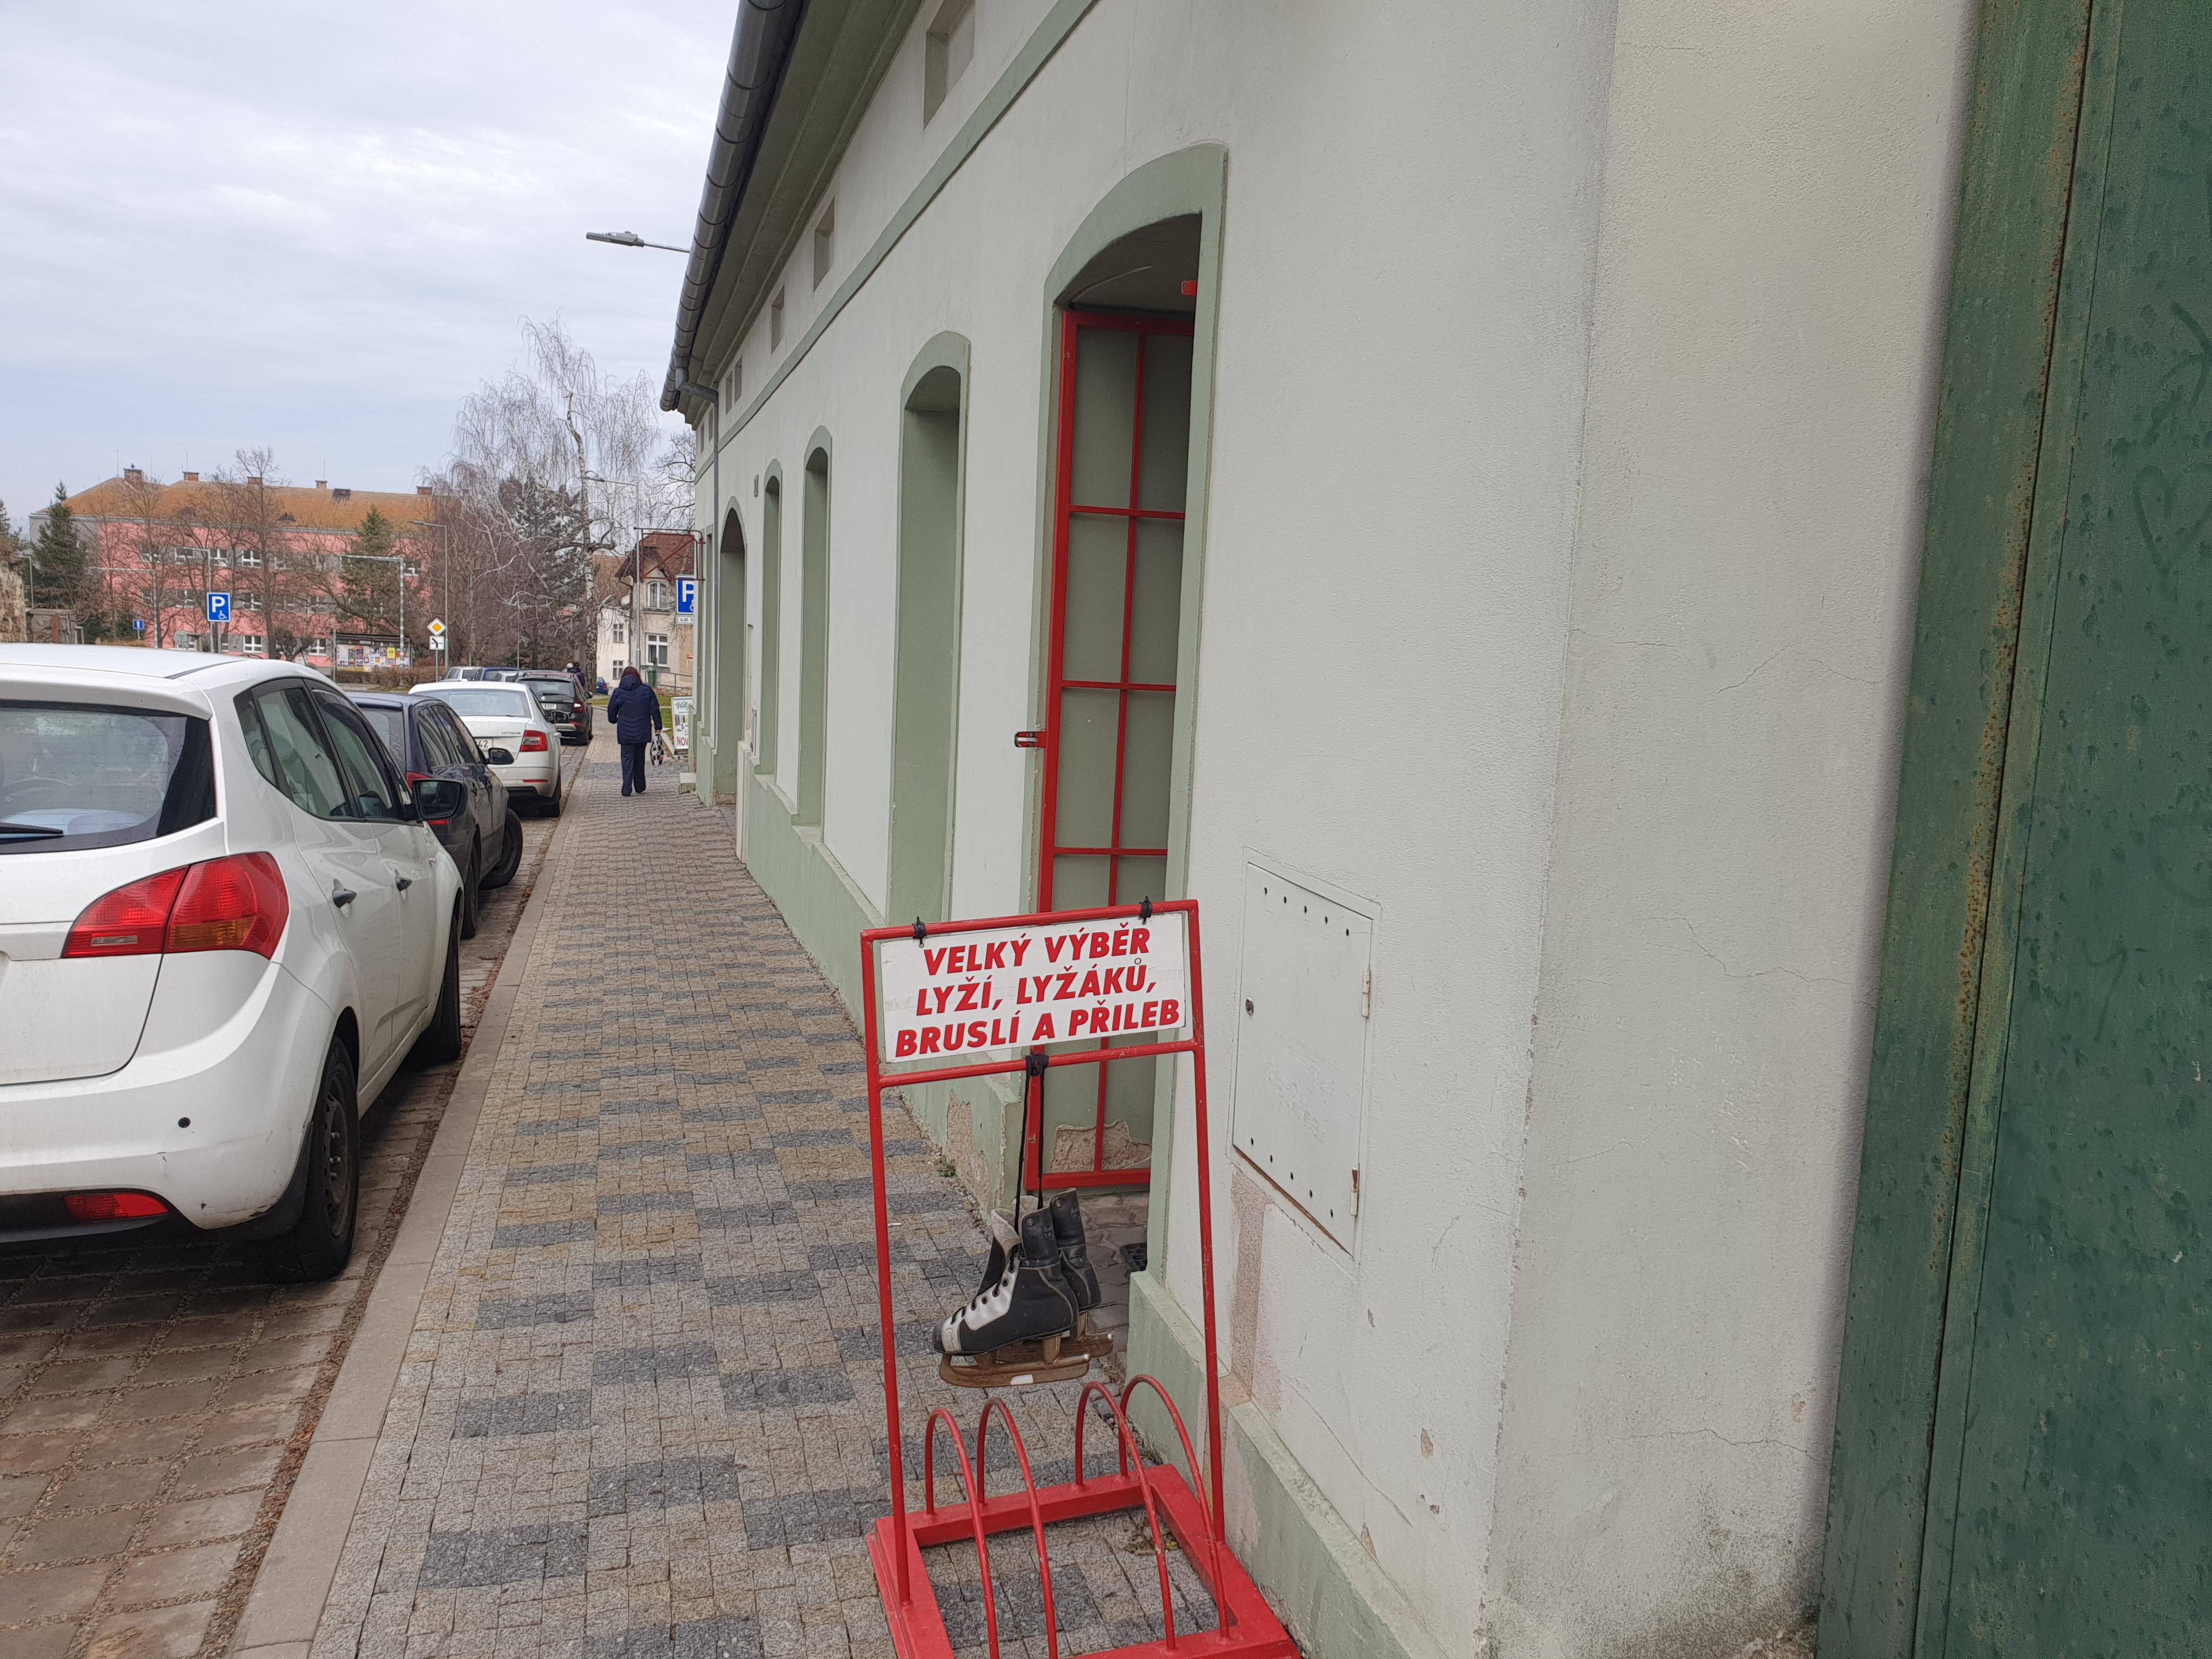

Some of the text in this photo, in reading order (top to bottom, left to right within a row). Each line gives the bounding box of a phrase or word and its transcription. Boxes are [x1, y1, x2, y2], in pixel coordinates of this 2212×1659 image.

[212, 596, 225, 613] P
[682, 580, 694, 602] P
[924, 922, 1151, 977] VELKÝ VÝBĚR
[916, 958, 1157, 1016] LYŽÍ, LYŽÁKŮ,
[895, 999, 1180, 1058] BRUSLÍ A PŘILEB
